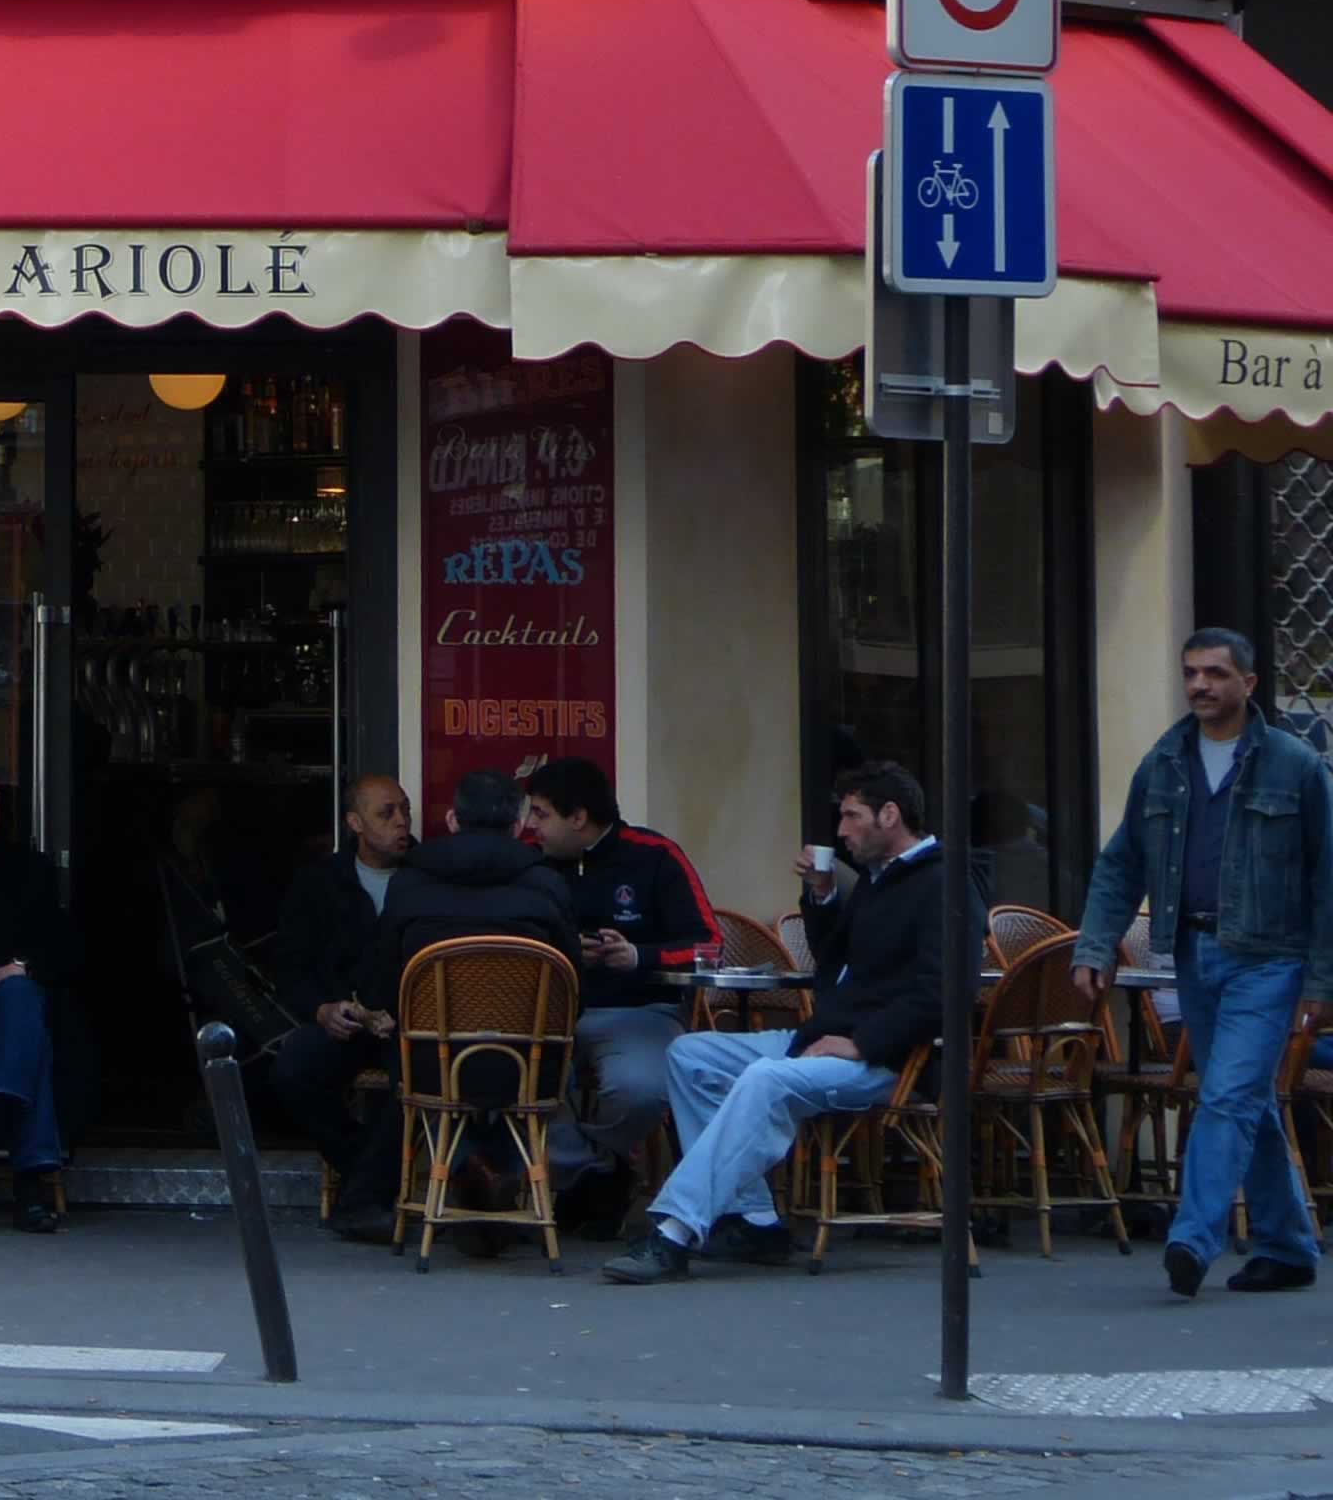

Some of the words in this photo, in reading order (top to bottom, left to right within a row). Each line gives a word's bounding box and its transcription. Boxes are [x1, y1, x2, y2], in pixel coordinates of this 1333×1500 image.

[1219, 338, 1291, 387] Bar
[1303, 343, 1323, 390] à
[443, 540, 584, 586] REPAS
[444, 698, 607, 738] DIGESTIFS
